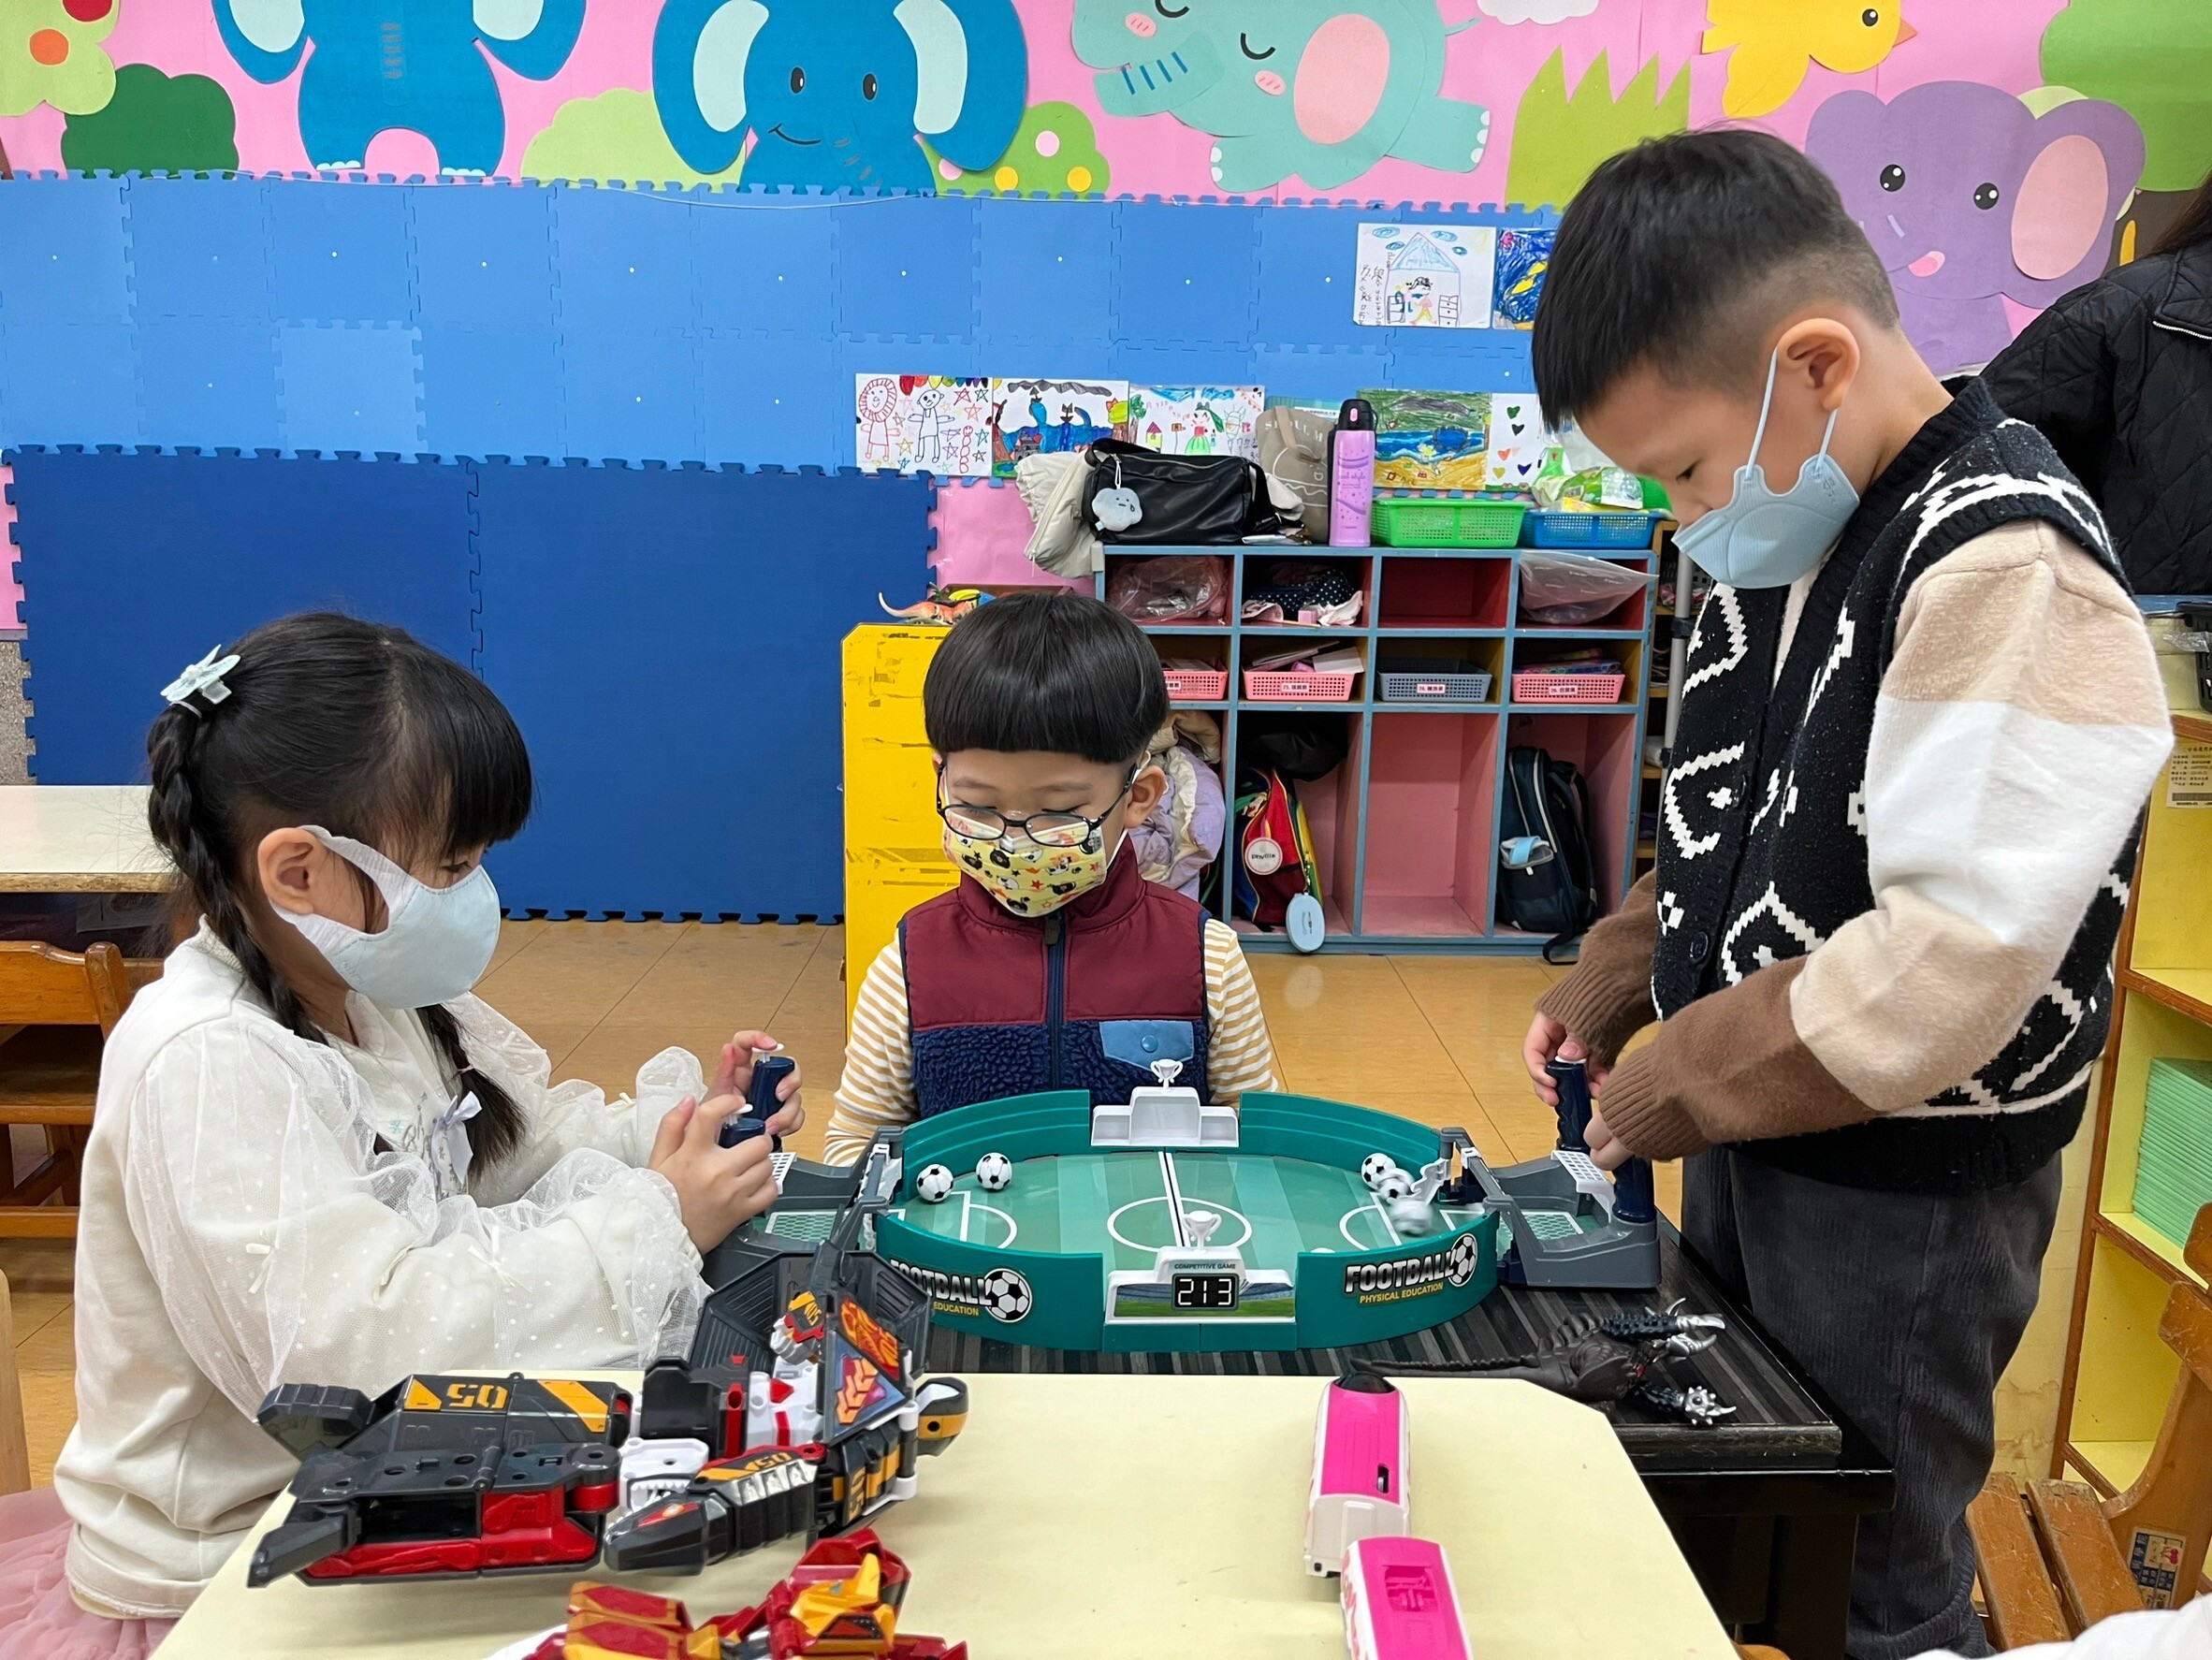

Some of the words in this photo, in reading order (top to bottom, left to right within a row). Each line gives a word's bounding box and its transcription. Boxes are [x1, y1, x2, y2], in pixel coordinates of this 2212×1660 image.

[1264, 419, 1309, 436] SUL
[1345, 1249, 1454, 1293] FOOTBALL
[1360, 1290, 1400, 1303] PHYSICAL
[1401, 1281, 1444, 1300] EDUCATION
[933, 1301, 980, 1317] EDUCATION
